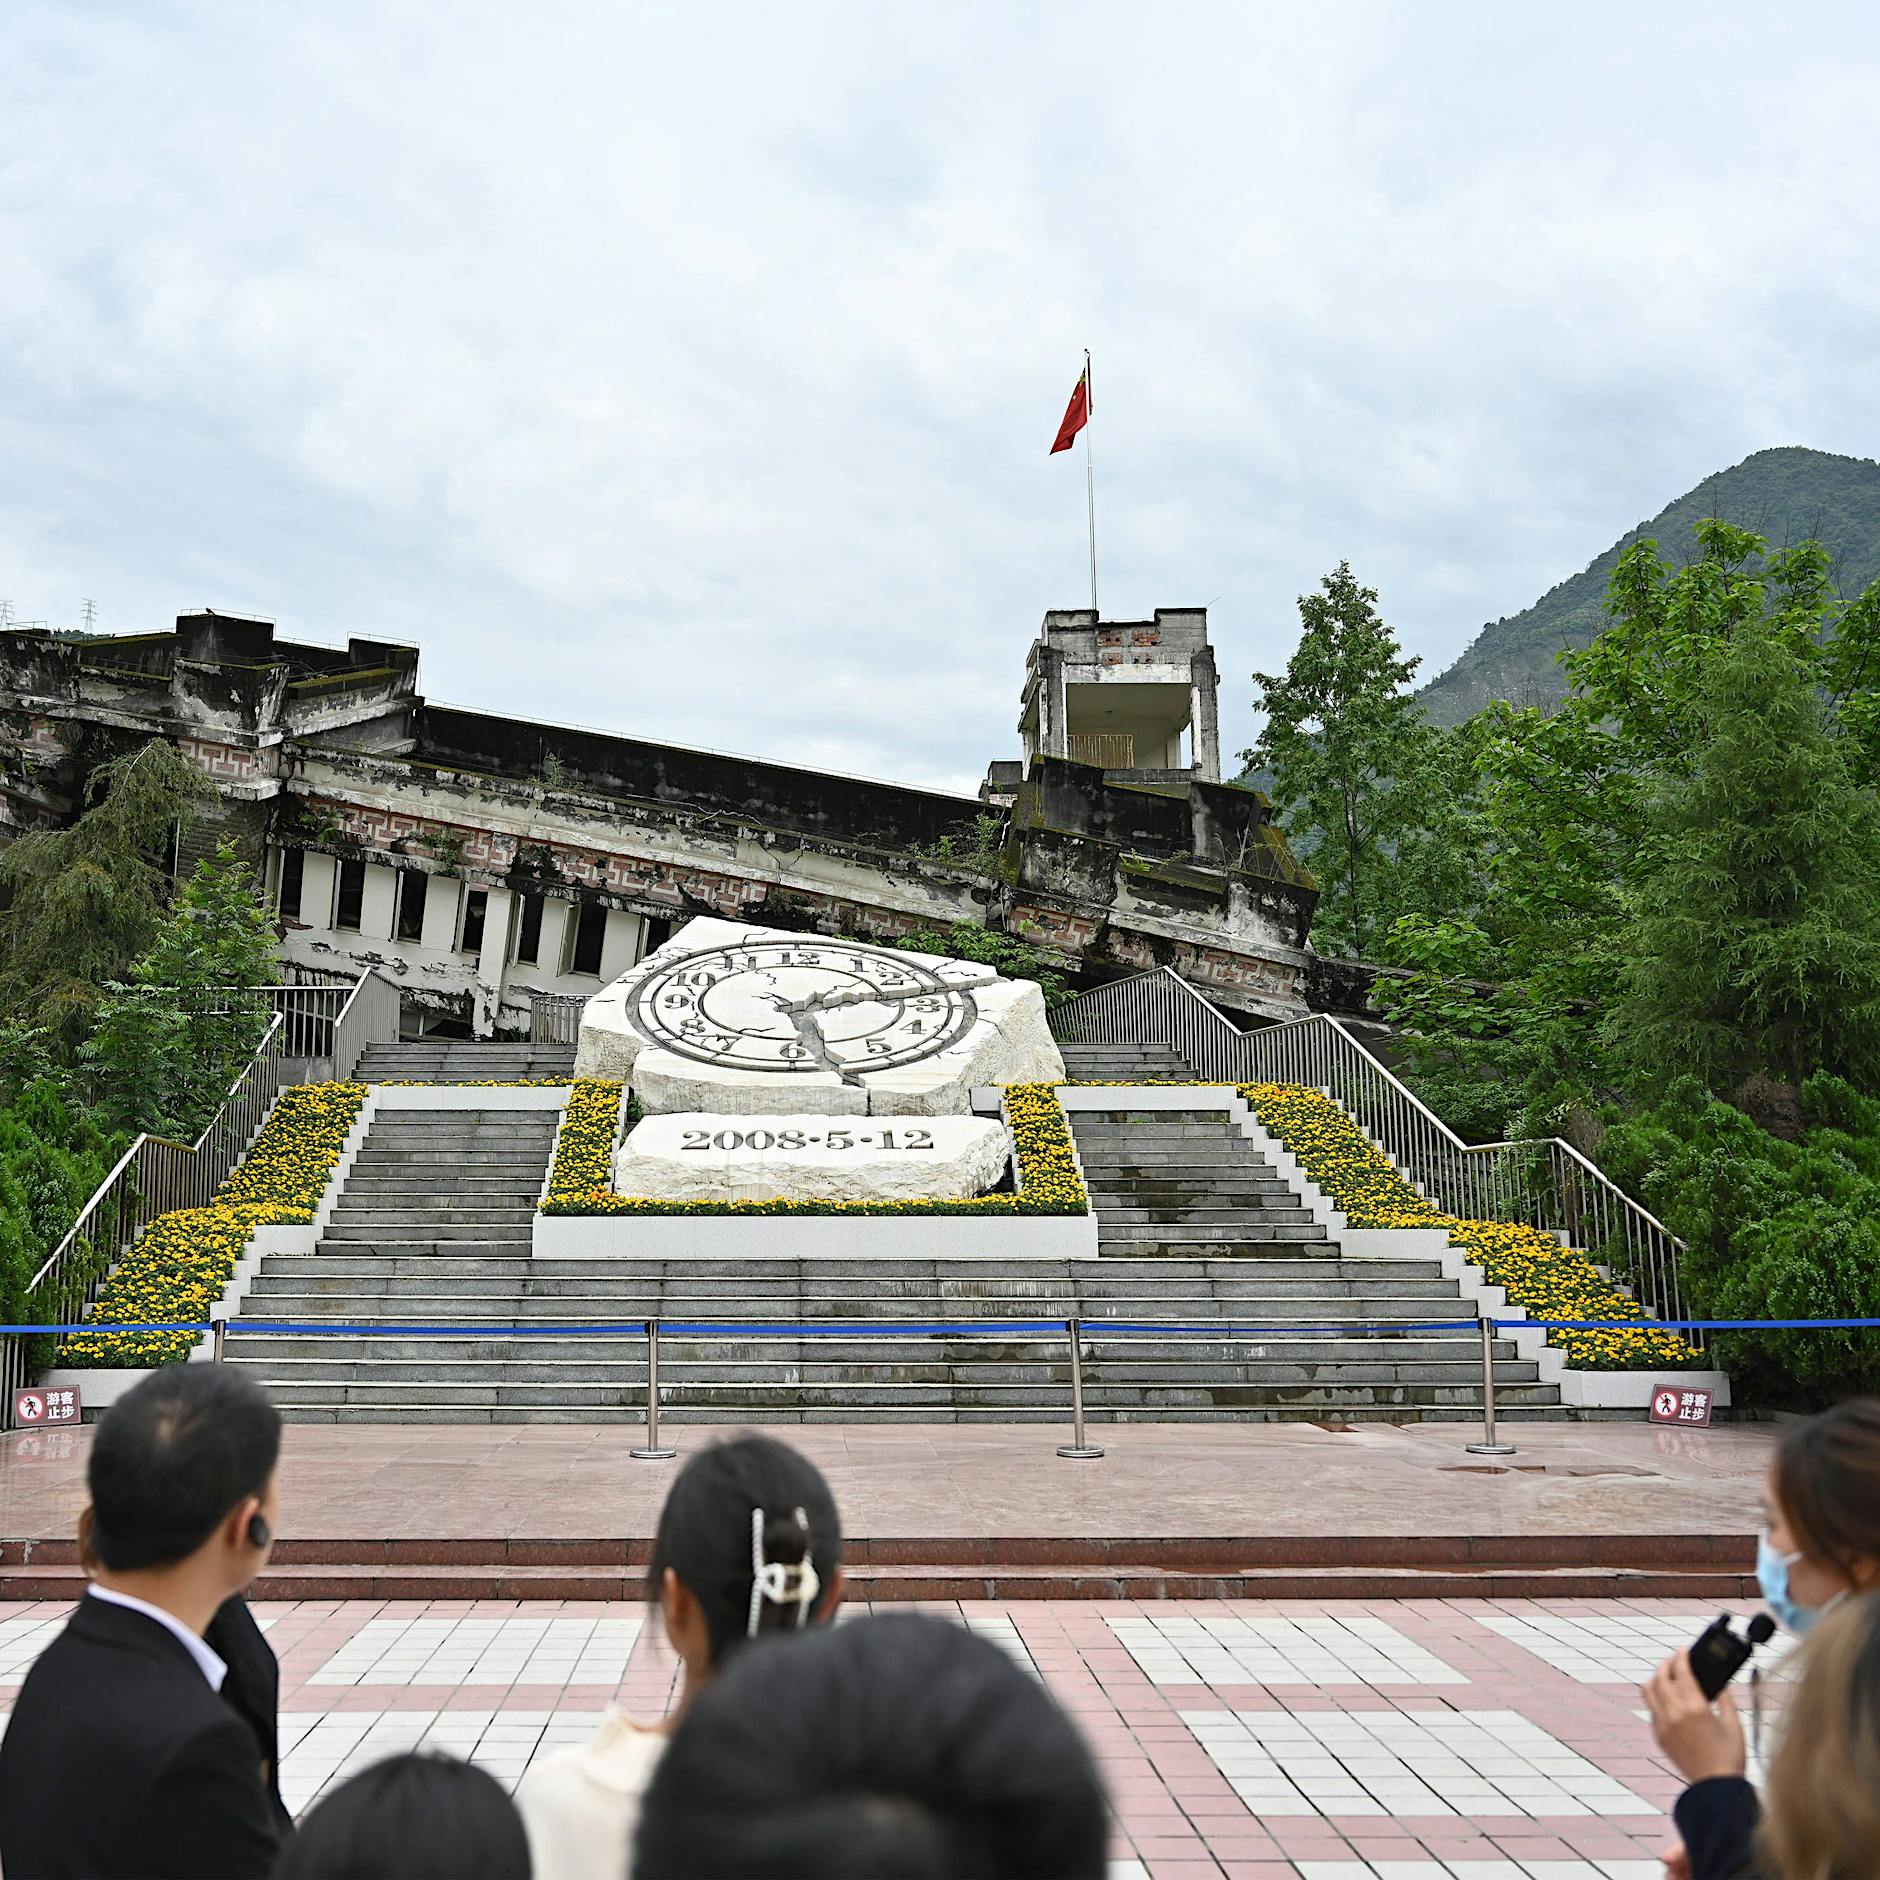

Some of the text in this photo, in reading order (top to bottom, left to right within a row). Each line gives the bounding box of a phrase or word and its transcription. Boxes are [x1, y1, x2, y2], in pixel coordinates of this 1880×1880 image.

[715, 954, 758, 971] 11
[776, 951, 823, 965] 12
[849, 958, 870, 973] 1
[670, 972, 716, 987] 10
[879, 971, 904, 986] 2
[664, 993, 690, 1009] 9
[915, 998, 941, 1013] 3
[680, 1018, 706, 1034] 8
[899, 1019, 927, 1034] 4
[716, 1033, 743, 1051] 7
[865, 1037, 892, 1054] 5
[779, 1042, 806, 1058] 6
[46, 1391, 74, 1406] 游客
[1681, 1392, 1708, 1407] 游客
[47, 1406, 75, 1419] 止步
[1679, 1406, 1705, 1421] 止步
